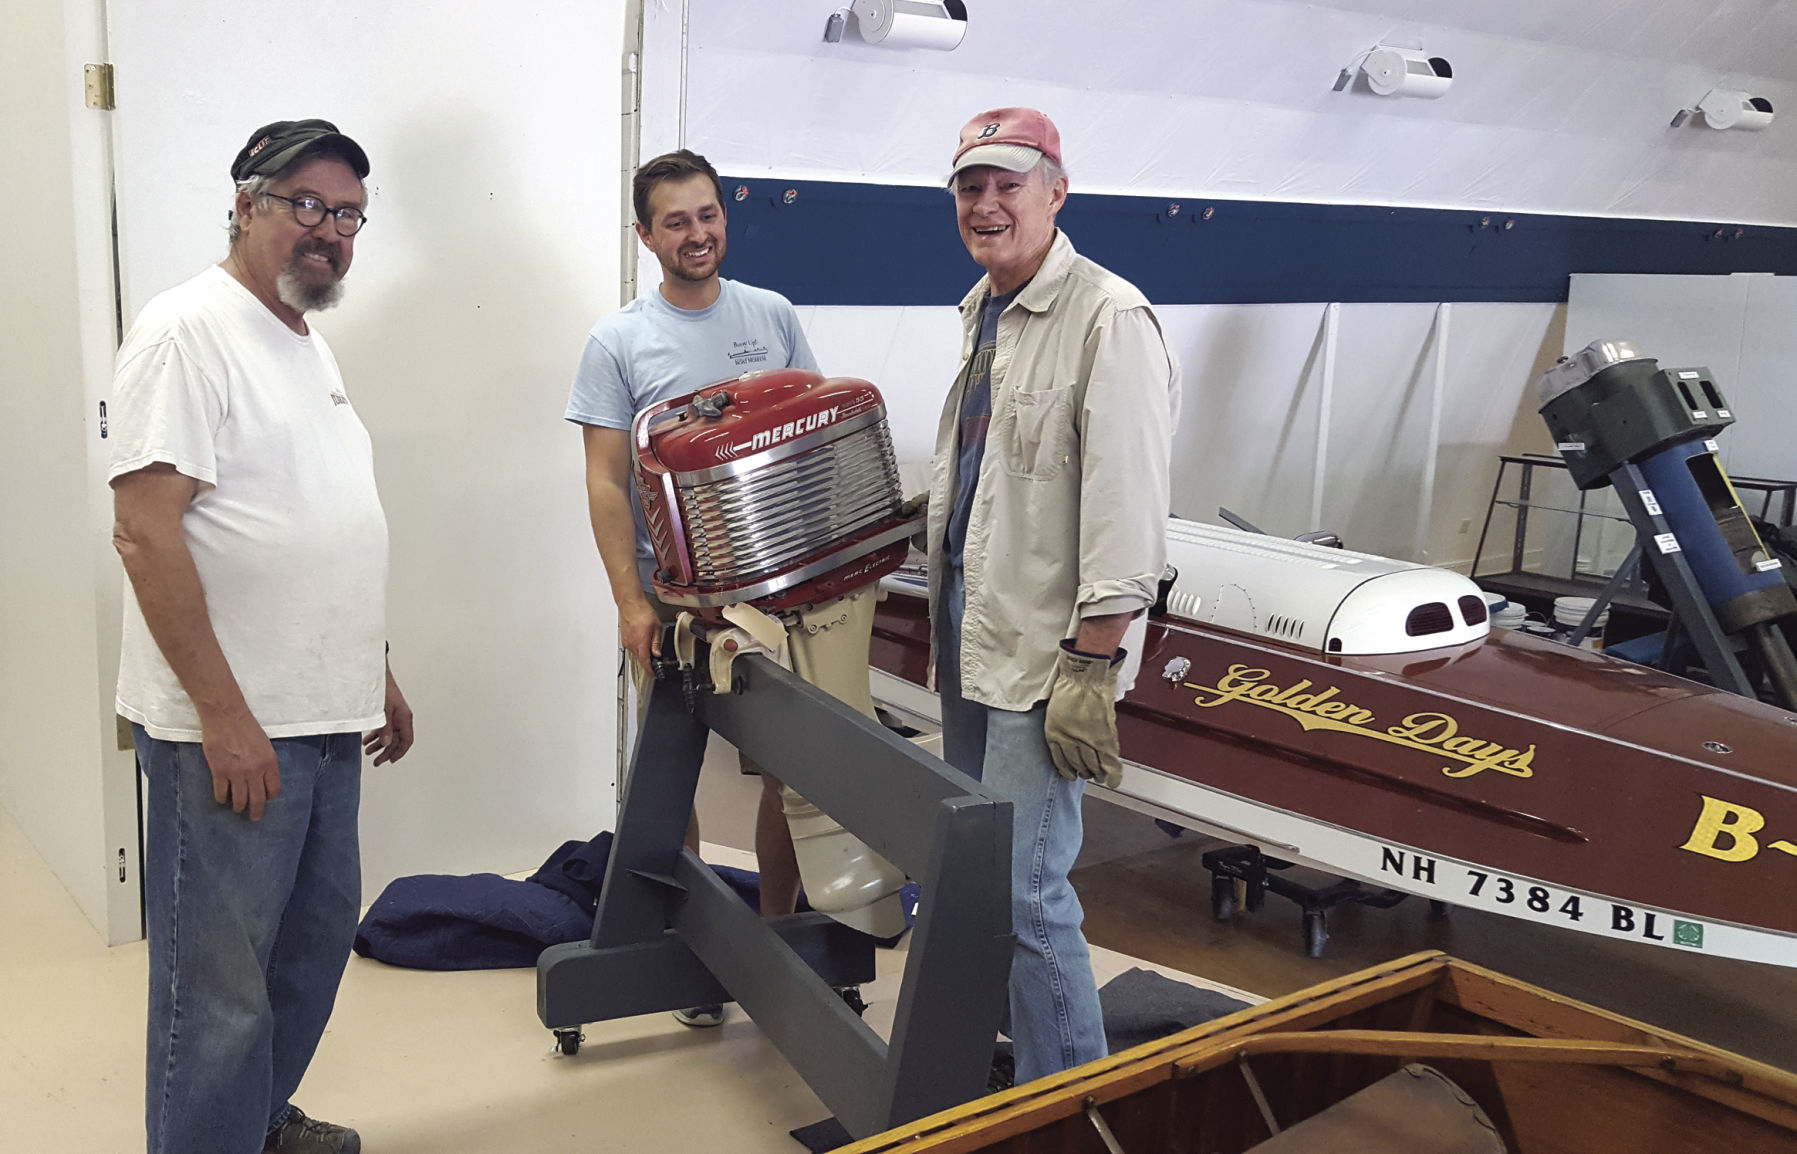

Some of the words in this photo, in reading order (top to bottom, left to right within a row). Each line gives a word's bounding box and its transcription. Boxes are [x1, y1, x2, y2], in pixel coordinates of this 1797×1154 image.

[977, 122, 1001, 139] B
[751, 405, 839, 451] MERCURY
[1194, 663, 1376, 727] Golden
[1387, 711, 1536, 779] Days
[1380, 846, 1437, 885] NH
[1467, 870, 1584, 922] 7384
[1611, 904, 1665, 941] BL
